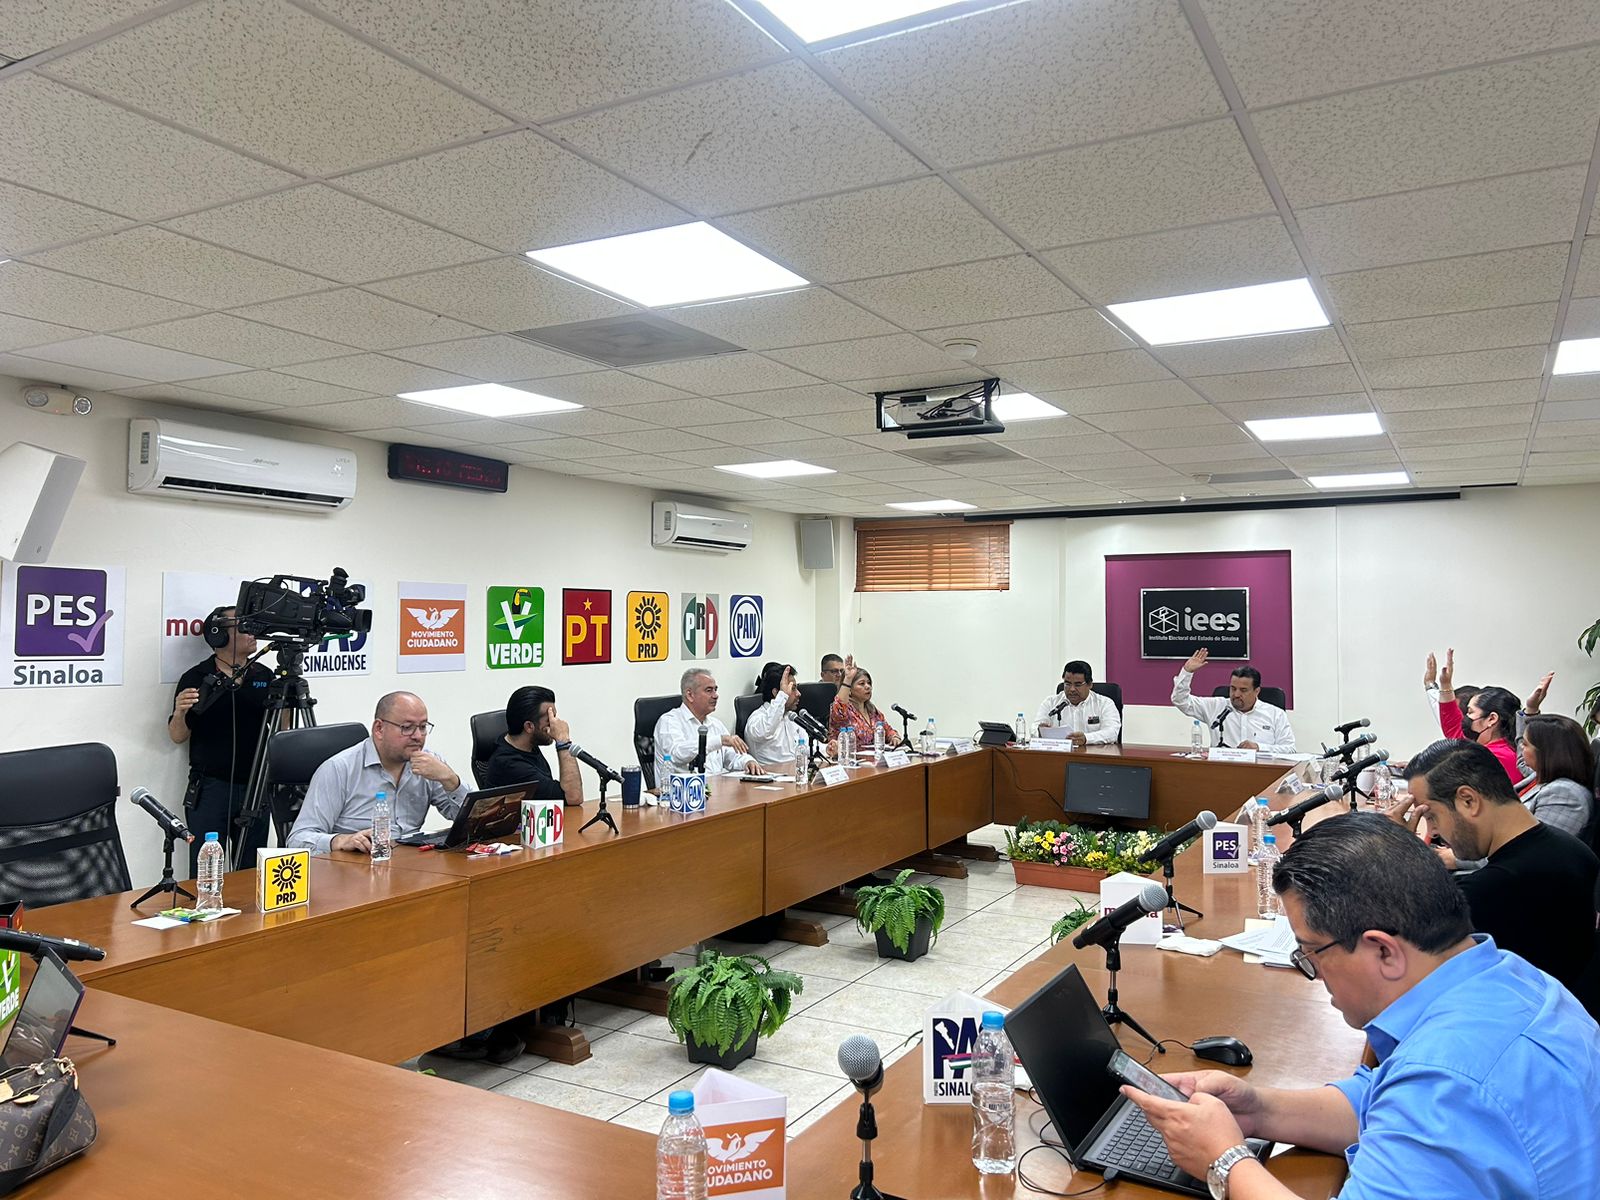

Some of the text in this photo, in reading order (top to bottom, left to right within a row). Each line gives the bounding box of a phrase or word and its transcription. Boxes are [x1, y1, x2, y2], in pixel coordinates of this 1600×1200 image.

[26, 593, 97, 628] PES
[1184, 607, 1240, 632] iees
[685, 602, 714, 641] PRI
[737, 613, 757, 639] PAN
[407, 638, 458, 648] CIUDADANO
[411, 630, 454, 639] MOVIMIENTO
[566, 615, 608, 658] PT
[489, 642, 542, 665] VERDE
[637, 643, 659, 658] PRD
[303, 654, 367, 672] SINALOENSE
[14, 664, 103, 685] Sinaloa
[689, 784, 702, 802] PAN
[538, 808, 561, 836] PRI
[1215, 840, 1237, 851] PES
[1212, 861, 1239, 869] Sinaloa
[276, 891, 297, 905] PRD
[932, 1017, 983, 1079] PA
[707, 1159, 767, 1175] OVIMIENTO
[706, 1168, 773, 1188] UDADANO
